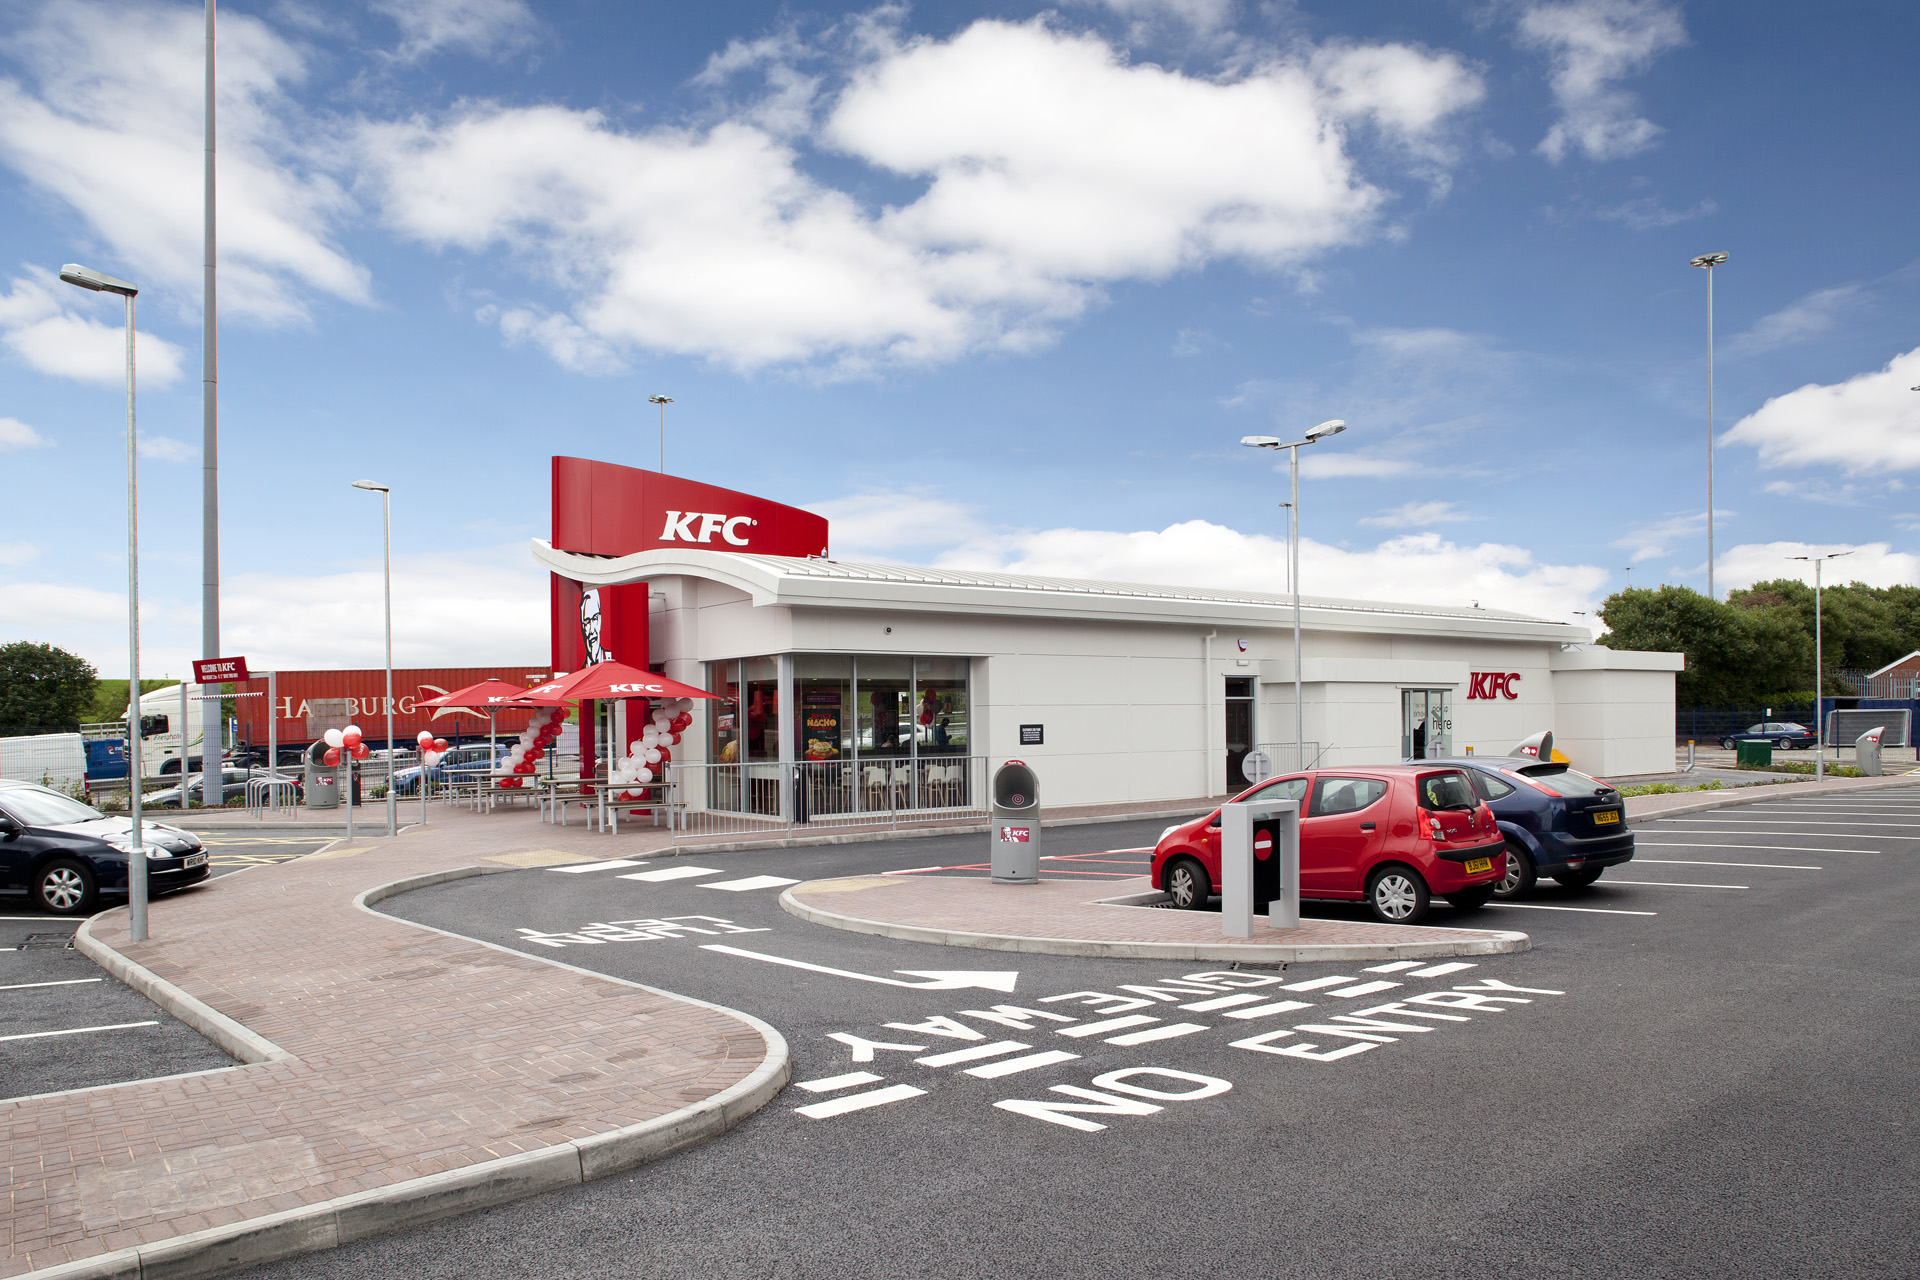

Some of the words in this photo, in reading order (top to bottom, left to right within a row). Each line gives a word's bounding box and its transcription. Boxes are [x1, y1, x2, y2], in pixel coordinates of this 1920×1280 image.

[659, 510, 752, 547] KFC
[222, 662, 236, 671] KFC
[610, 683, 664, 693] KFC
[1467, 672, 1521, 700] KFC
[276, 695, 416, 719] HABURG
[807, 718, 836, 726] NACHO
[1432, 717, 1452, 730] here
[515, 915, 734, 939] LEFT
[525, 923, 773, 947] TURN
[1037, 971, 1284, 1015] GIVE
[825, 1003, 1080, 1062] WAY
[992, 1066, 1234, 1132] NO
[1228, 979, 1567, 1062] ENTRY
